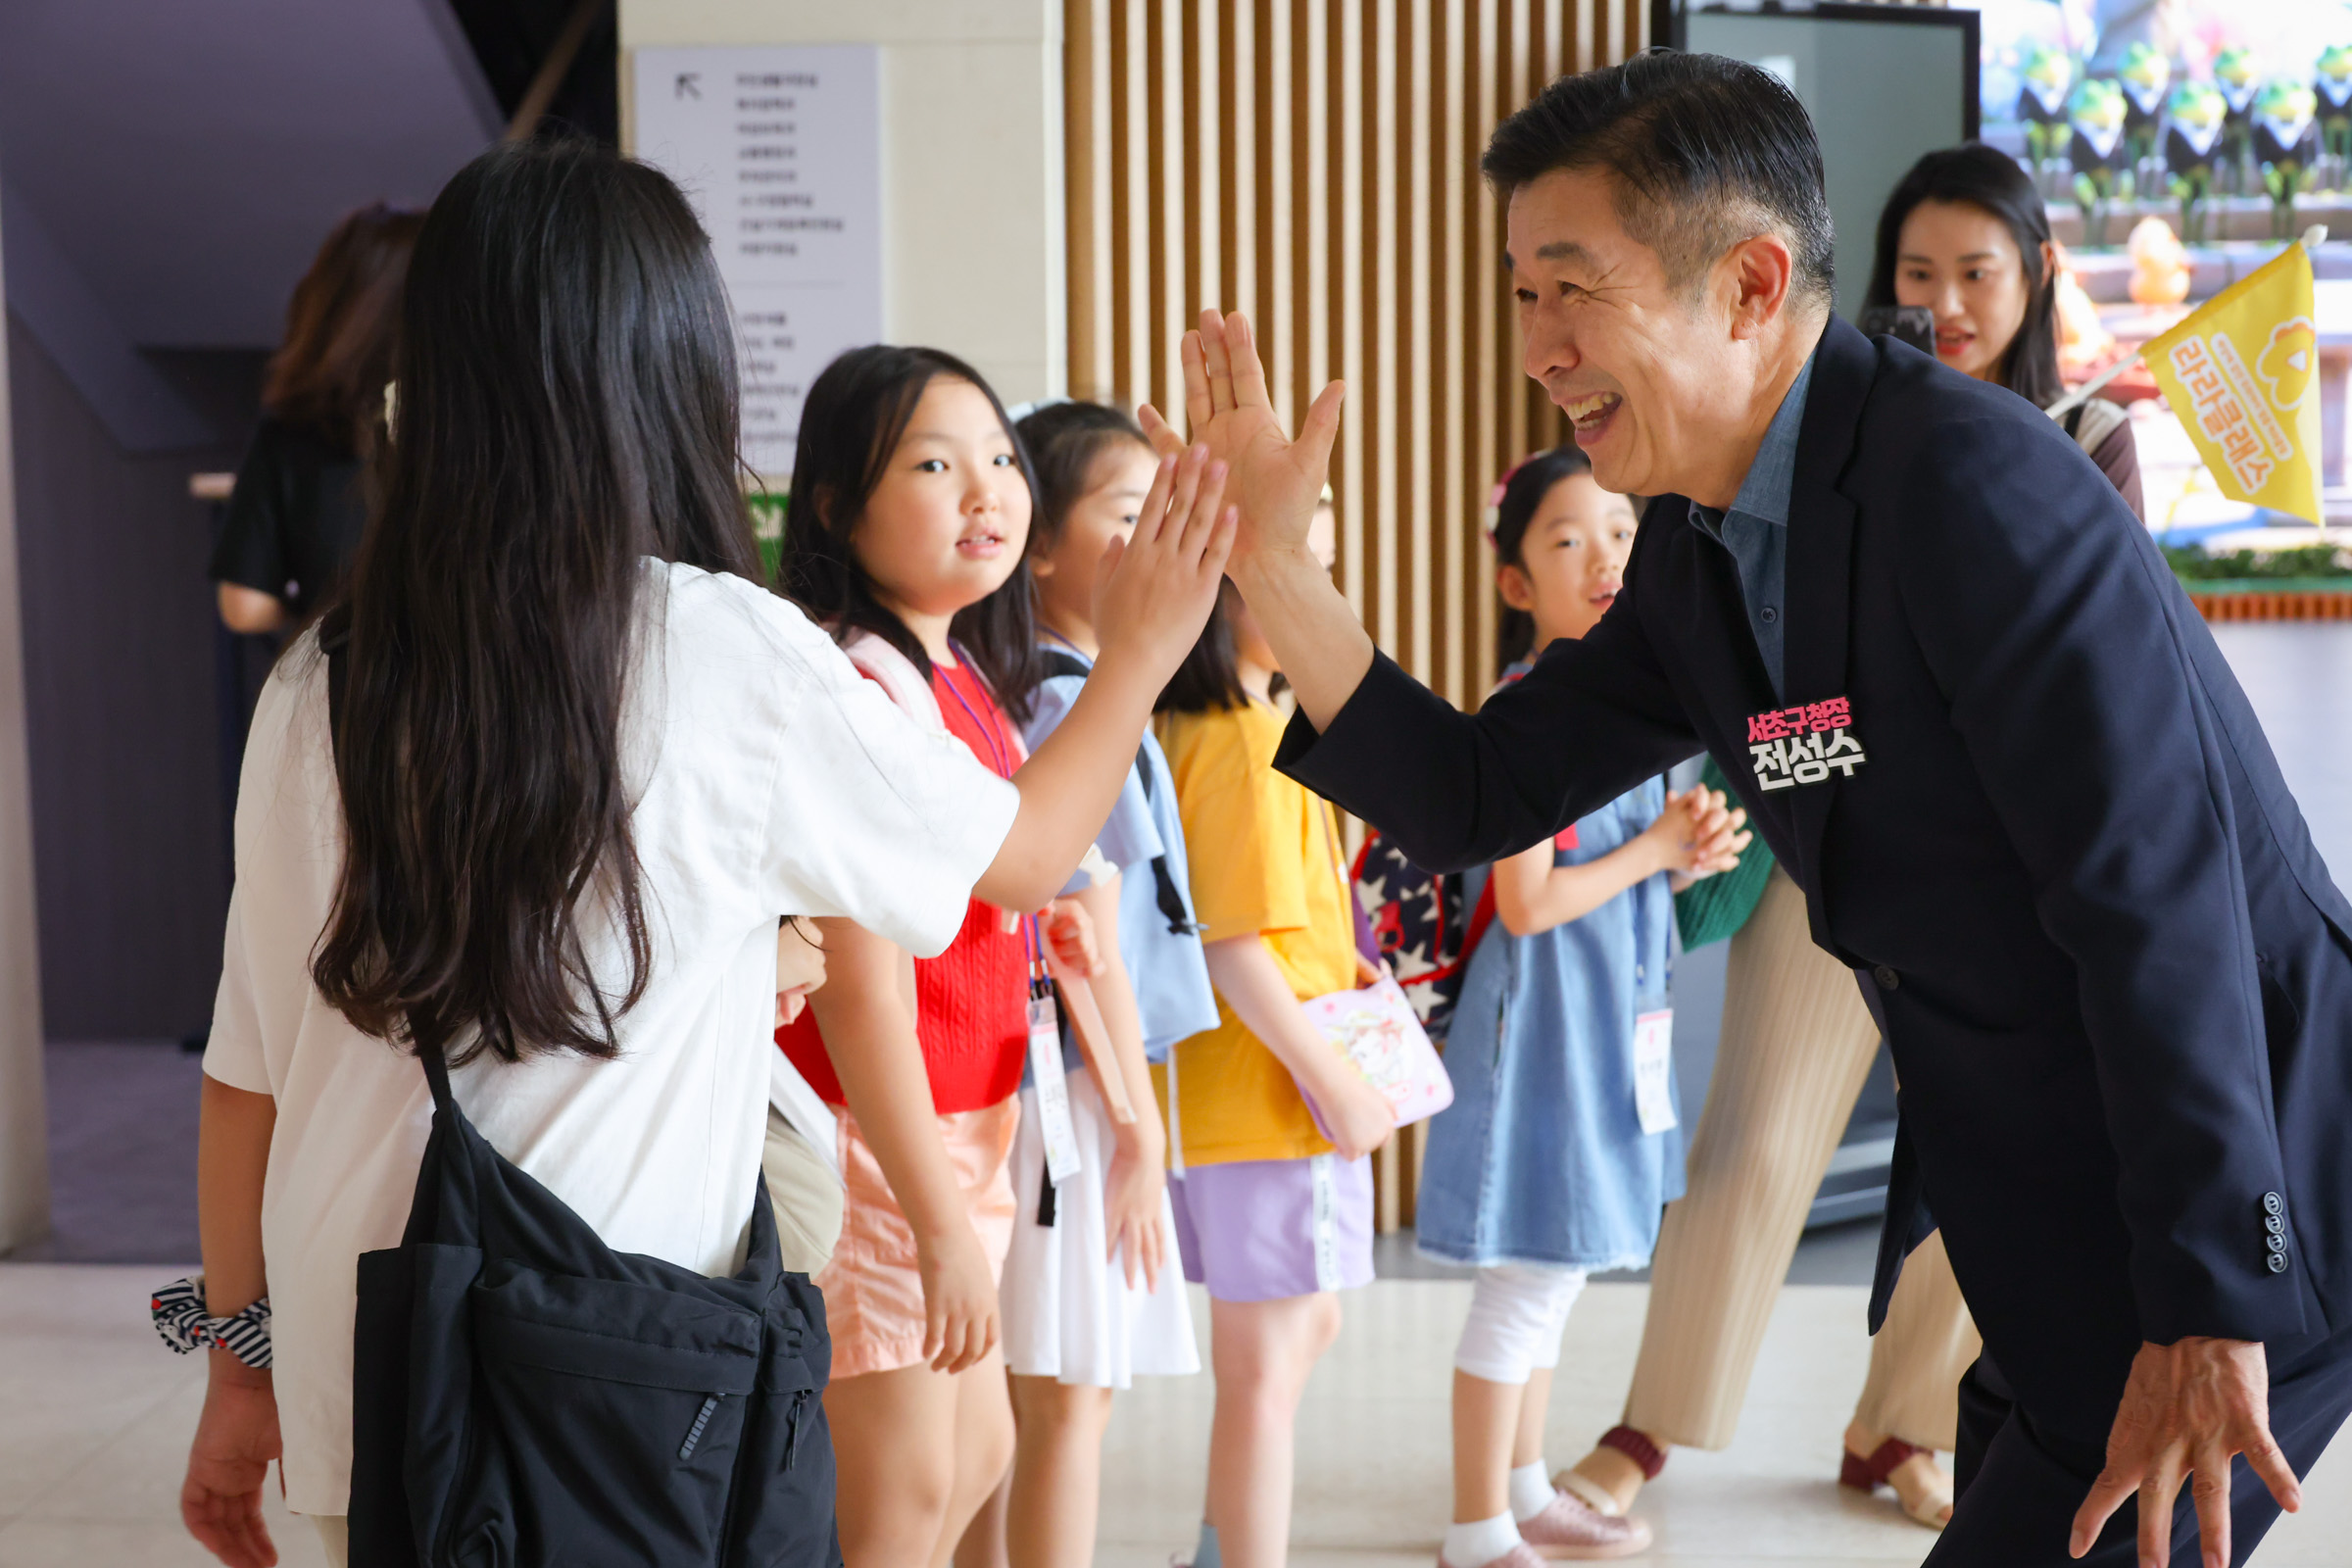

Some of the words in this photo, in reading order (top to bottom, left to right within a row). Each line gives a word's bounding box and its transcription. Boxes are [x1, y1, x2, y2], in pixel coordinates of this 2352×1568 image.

[2173, 341, 2270, 490] 라라클래스
[1747, 697, 1851, 743] 서초구청장
[1749, 727, 1866, 792] 전성수
